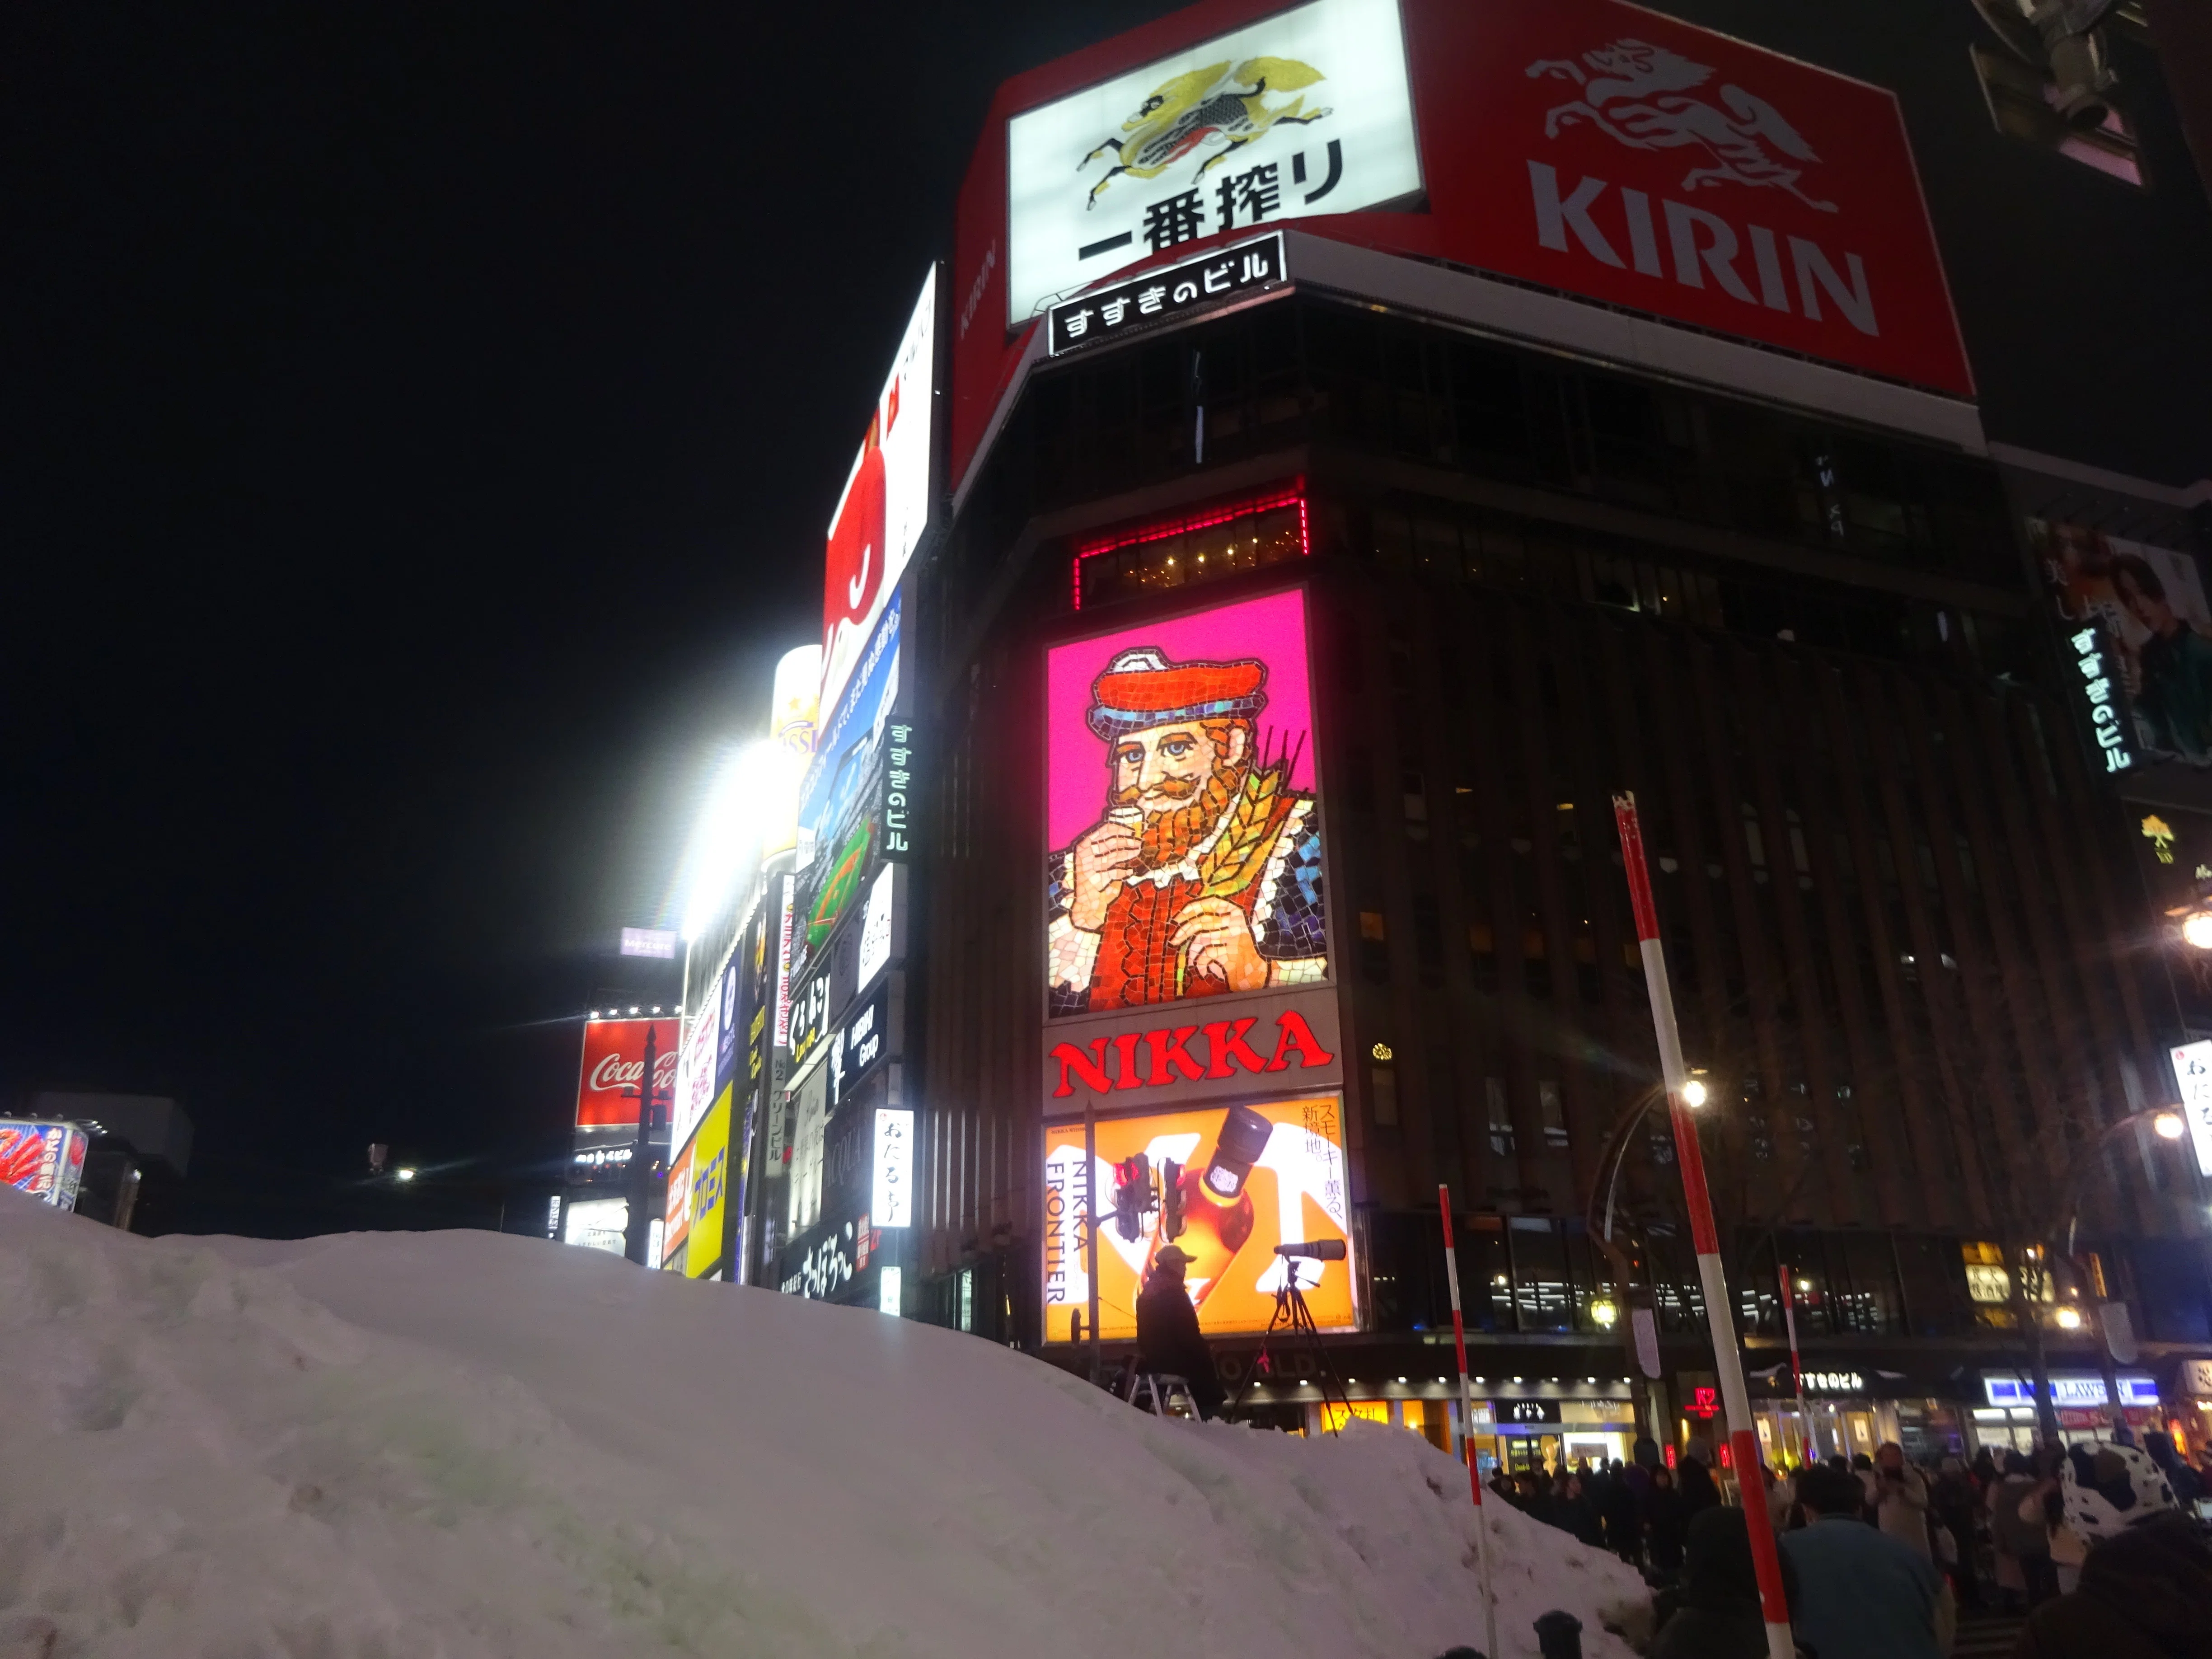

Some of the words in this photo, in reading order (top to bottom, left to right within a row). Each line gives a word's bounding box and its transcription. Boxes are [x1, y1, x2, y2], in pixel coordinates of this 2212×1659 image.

[1078, 139, 1344, 261] 一番搾り
[1526, 159, 1879, 337] KIRIN
[1064, 253, 1269, 338] すすきのビル
[2071, 628, 2132, 773] すすきのビル
[887, 724, 913, 851] すすきのビル
[624, 939, 671, 951] Mercure
[851, 1004, 874, 1050] HIBIKI
[860, 1034, 879, 1067] Group
[1049, 1010, 1335, 1098] NIKKA
[769, 1090, 783, 1161] グリーンビル
[1302, 1106, 1322, 1162] 新境地。
[2187, 1058, 2212, 1141] おたる
[692, 1145, 726, 1229] プロミス
[1073, 1161, 1088, 1252] NIKKA
[1047, 1162, 1065, 1305] FRONTIER
[2063, 1382, 2126, 1397] LAWSN
